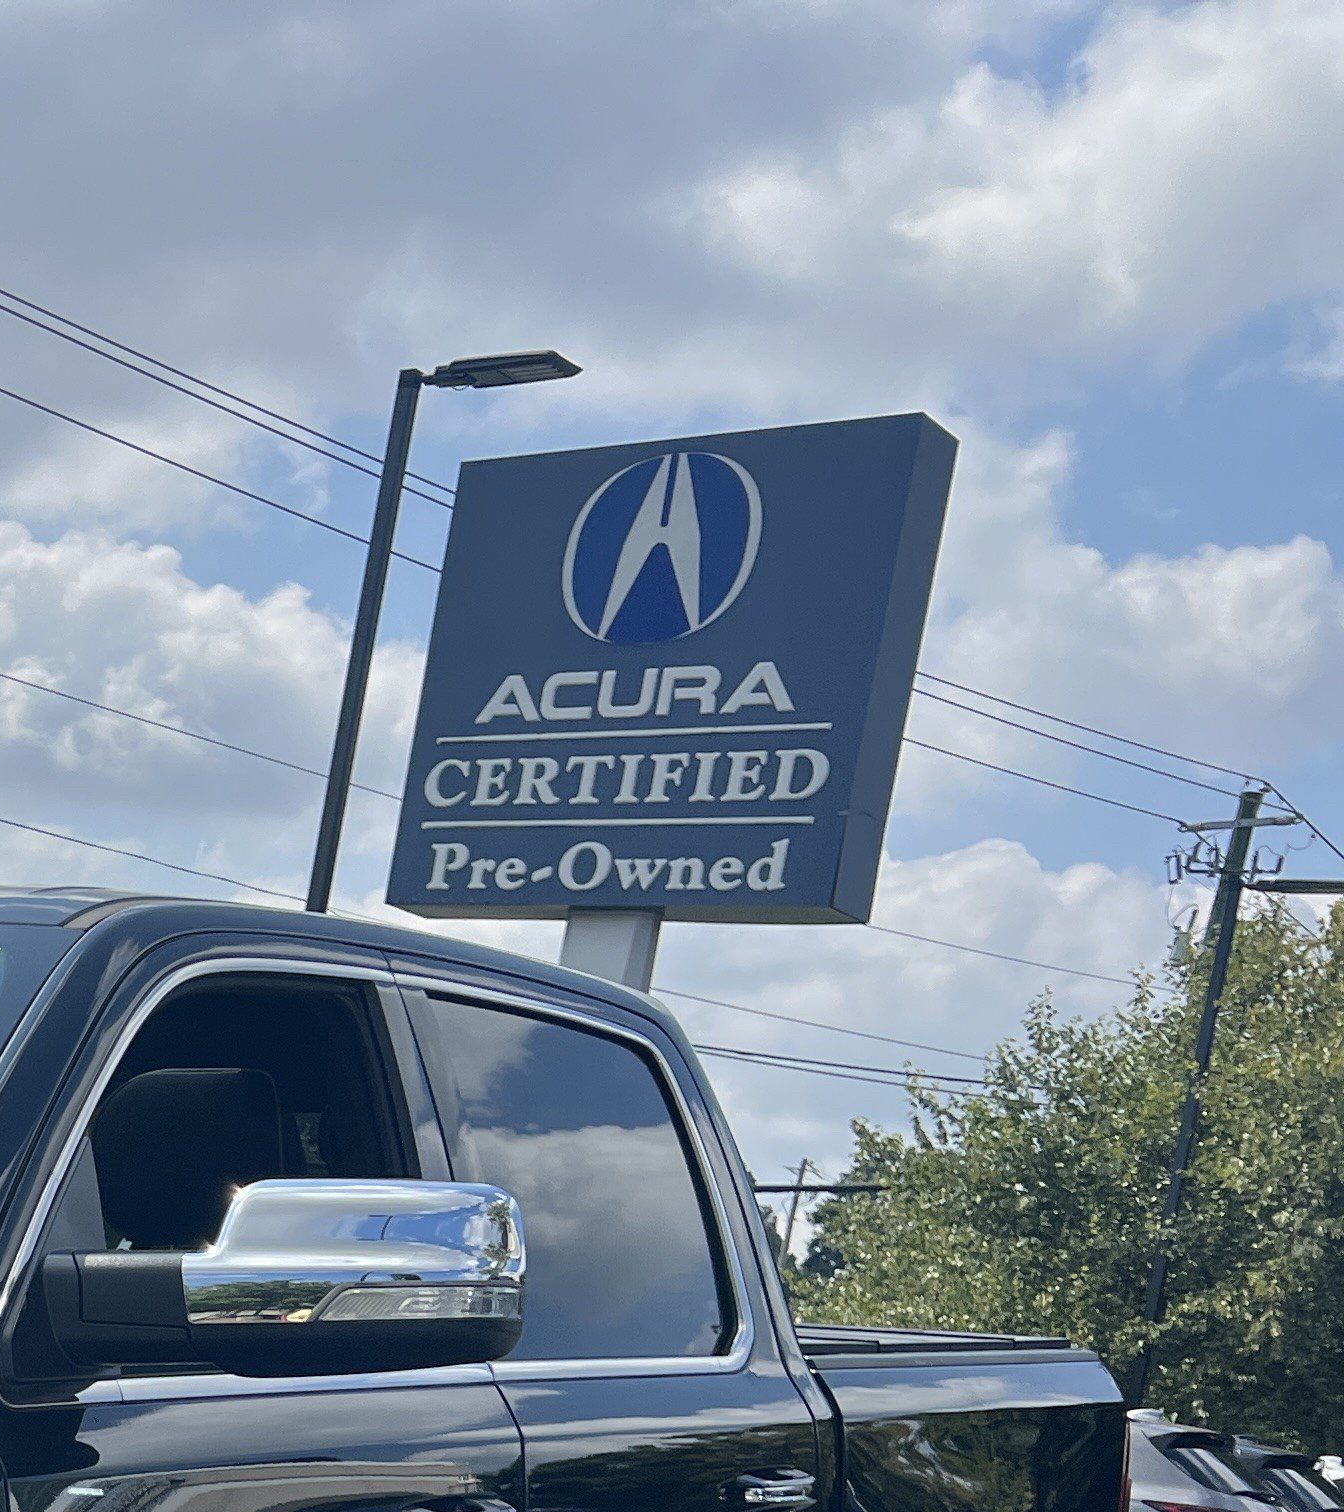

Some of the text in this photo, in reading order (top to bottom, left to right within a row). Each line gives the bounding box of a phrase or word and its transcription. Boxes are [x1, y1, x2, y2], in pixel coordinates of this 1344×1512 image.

[474, 660, 795, 725] ACURA
[423, 747, 830, 808] CERTIFIED
[426, 837, 791, 892] Pre-Owned
